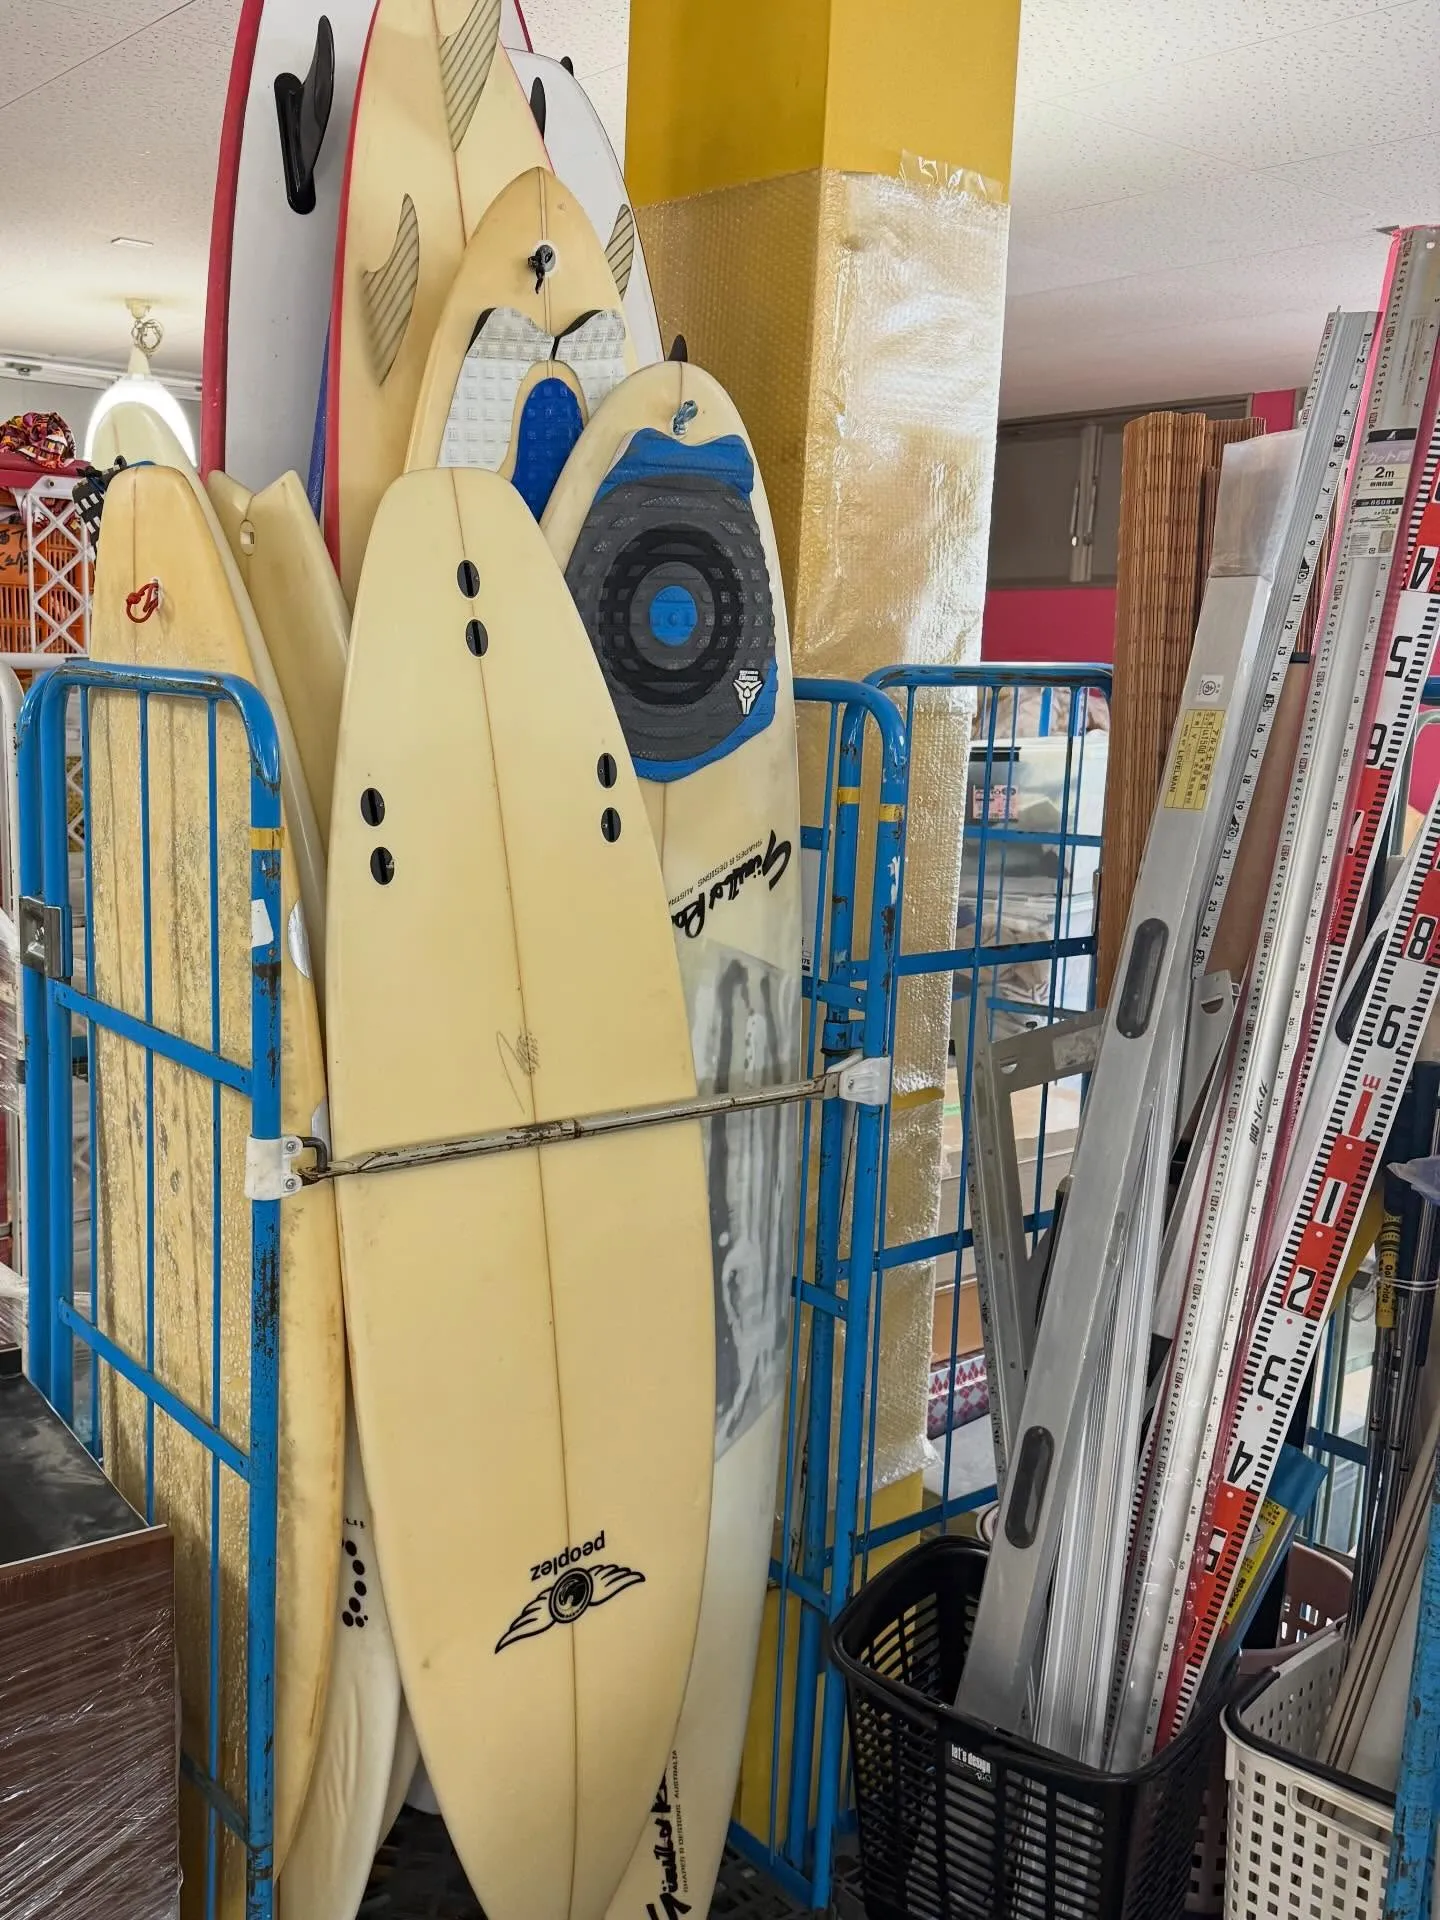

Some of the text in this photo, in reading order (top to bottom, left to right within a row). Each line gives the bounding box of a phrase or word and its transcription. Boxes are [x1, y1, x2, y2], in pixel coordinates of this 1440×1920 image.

[1374, 466, 1395, 479] 2m
[1409, 547, 1434, 590] 4
[1292, 594, 1301, 602] 11
[1284, 620, 1295, 630] 12
[1277, 646, 1287, 656] 13
[1385, 635, 1413, 679] 5
[1270, 672, 1280, 682] 14
[1263, 693, 1275, 708] 15
[1256, 723, 1266, 733] 16
[1250, 749, 1259, 759] 17
[1169, 749, 1185, 793] LEVELMAN
[1242, 774, 1252, 785] 18
[1235, 800, 1245, 810] 19
[1228, 823, 1240, 837] 20
[1221, 849, 1232, 860] 21
[697, 857, 728, 888] DESIGNS
[1214, 874, 1224, 887] 22
[1208, 900, 1217, 912] 23
[1201, 925, 1211, 938] 24
[1407, 916, 1436, 960] 8
[1321, 1181, 1341, 1224] 1
[1286, 1267, 1317, 1313] 2
[1258, 1354, 1287, 1401] 3
[1227, 1440, 1254, 1484] 4
[529, 1529, 606, 1582] peoplez
[951, 1743, 967, 1763] let's
[967, 1752, 991, 1774] design
